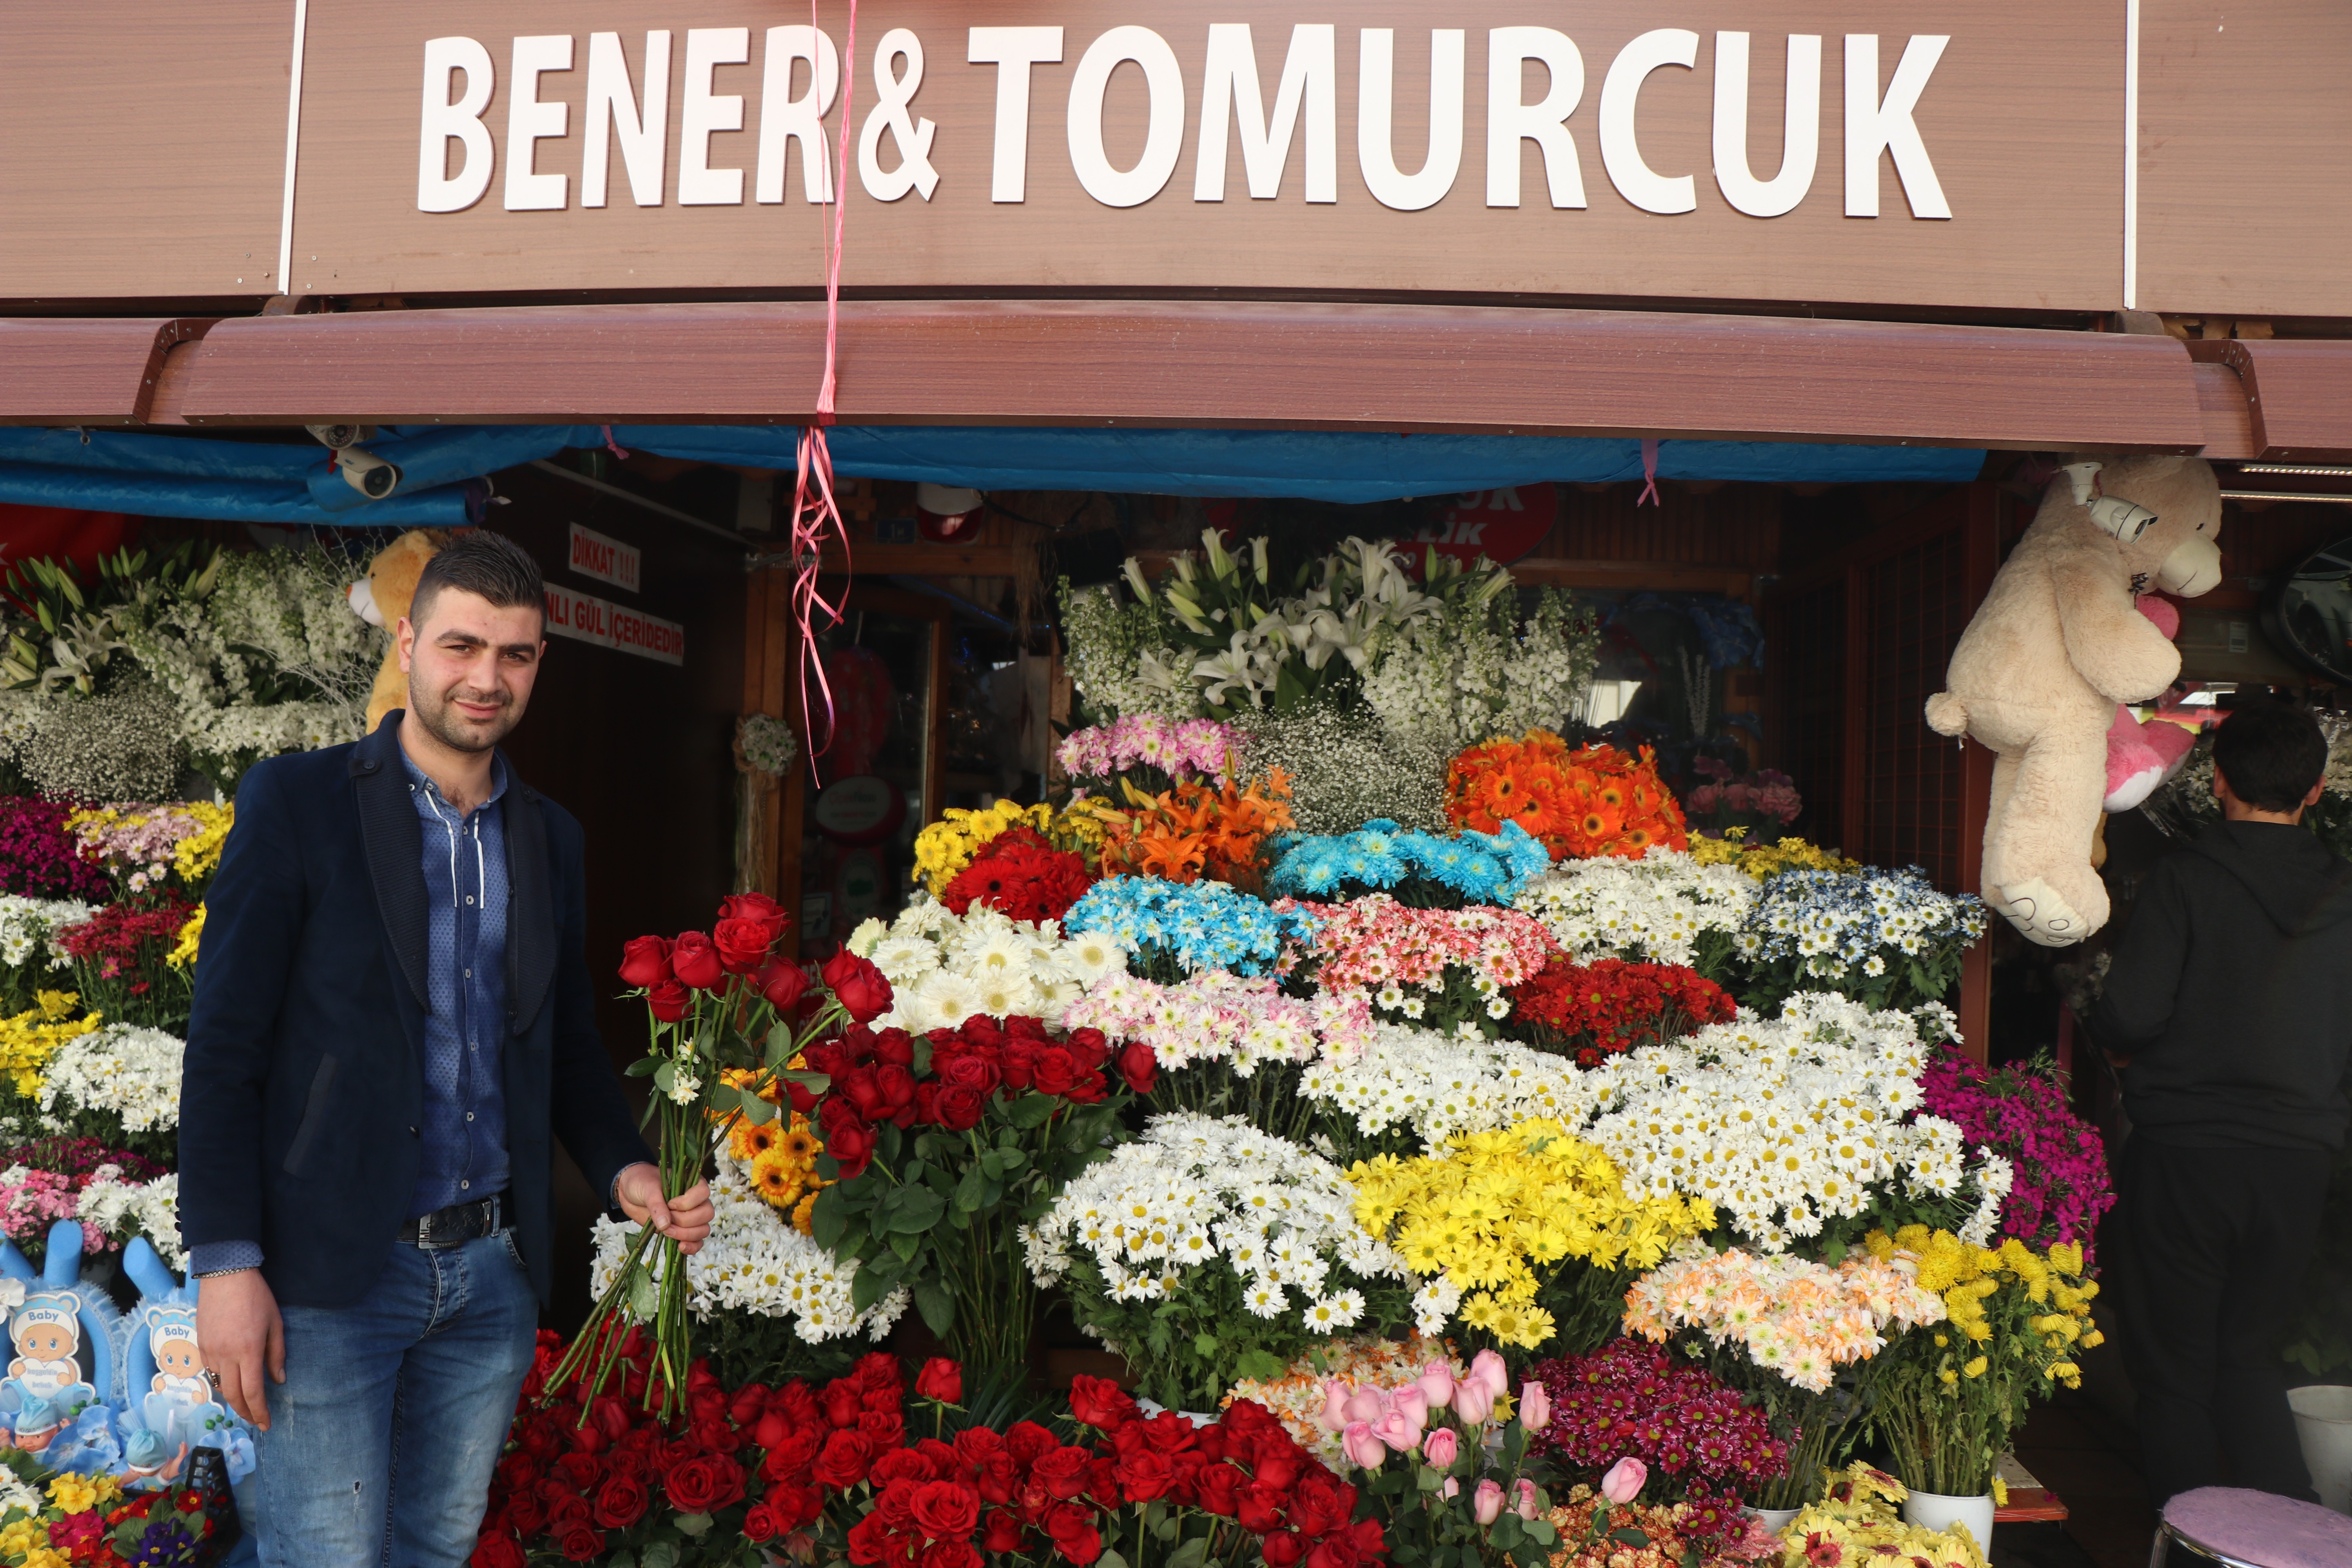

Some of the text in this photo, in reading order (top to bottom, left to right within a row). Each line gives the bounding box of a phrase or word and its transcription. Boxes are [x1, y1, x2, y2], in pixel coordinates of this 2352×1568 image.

[968, 23, 1954, 220] TOMURCUK
[572, 529, 615, 576] DİKKAT
[544, 590, 569, 626] NLI
[575, 599, 605, 635] GÜL
[28, 1310, 59, 1323] Baby
[164, 1326, 190, 1339] Baby
